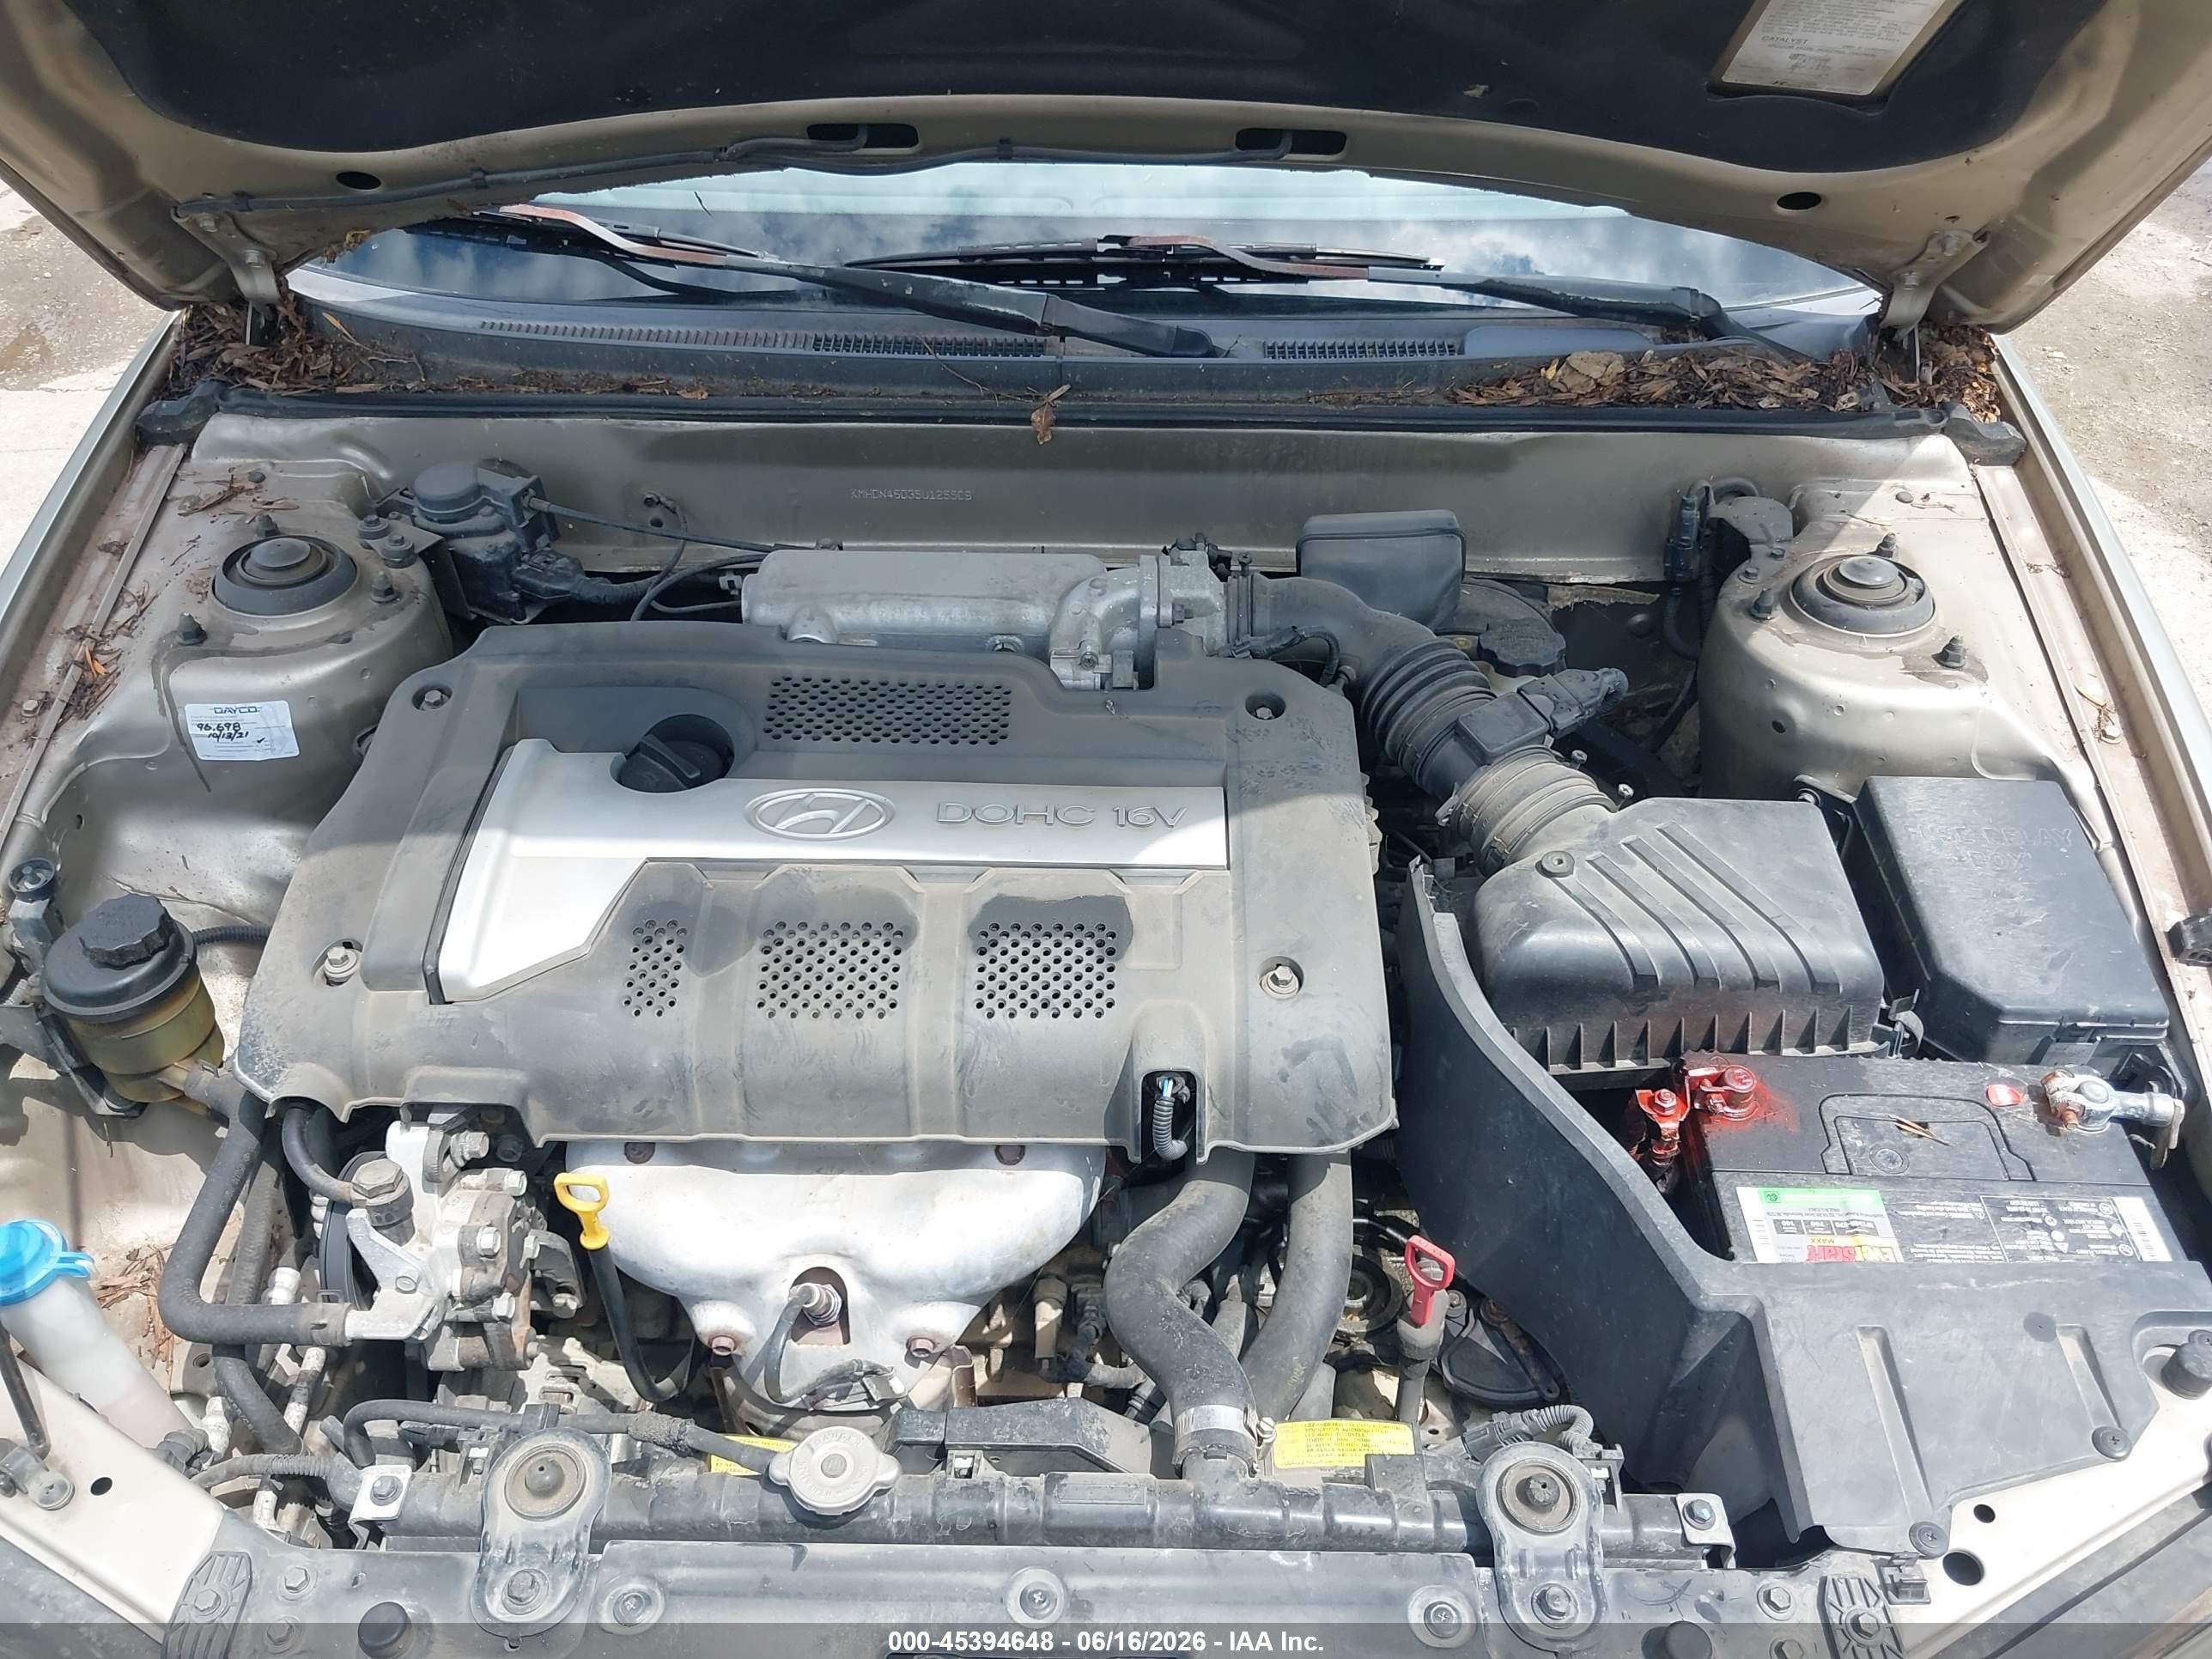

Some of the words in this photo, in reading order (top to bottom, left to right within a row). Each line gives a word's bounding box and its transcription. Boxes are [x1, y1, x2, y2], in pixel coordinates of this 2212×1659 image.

[213, 706, 258, 714] DAYCO
[937, 802, 1096, 827] DOHC
[1112, 805, 1188, 828] 16V
